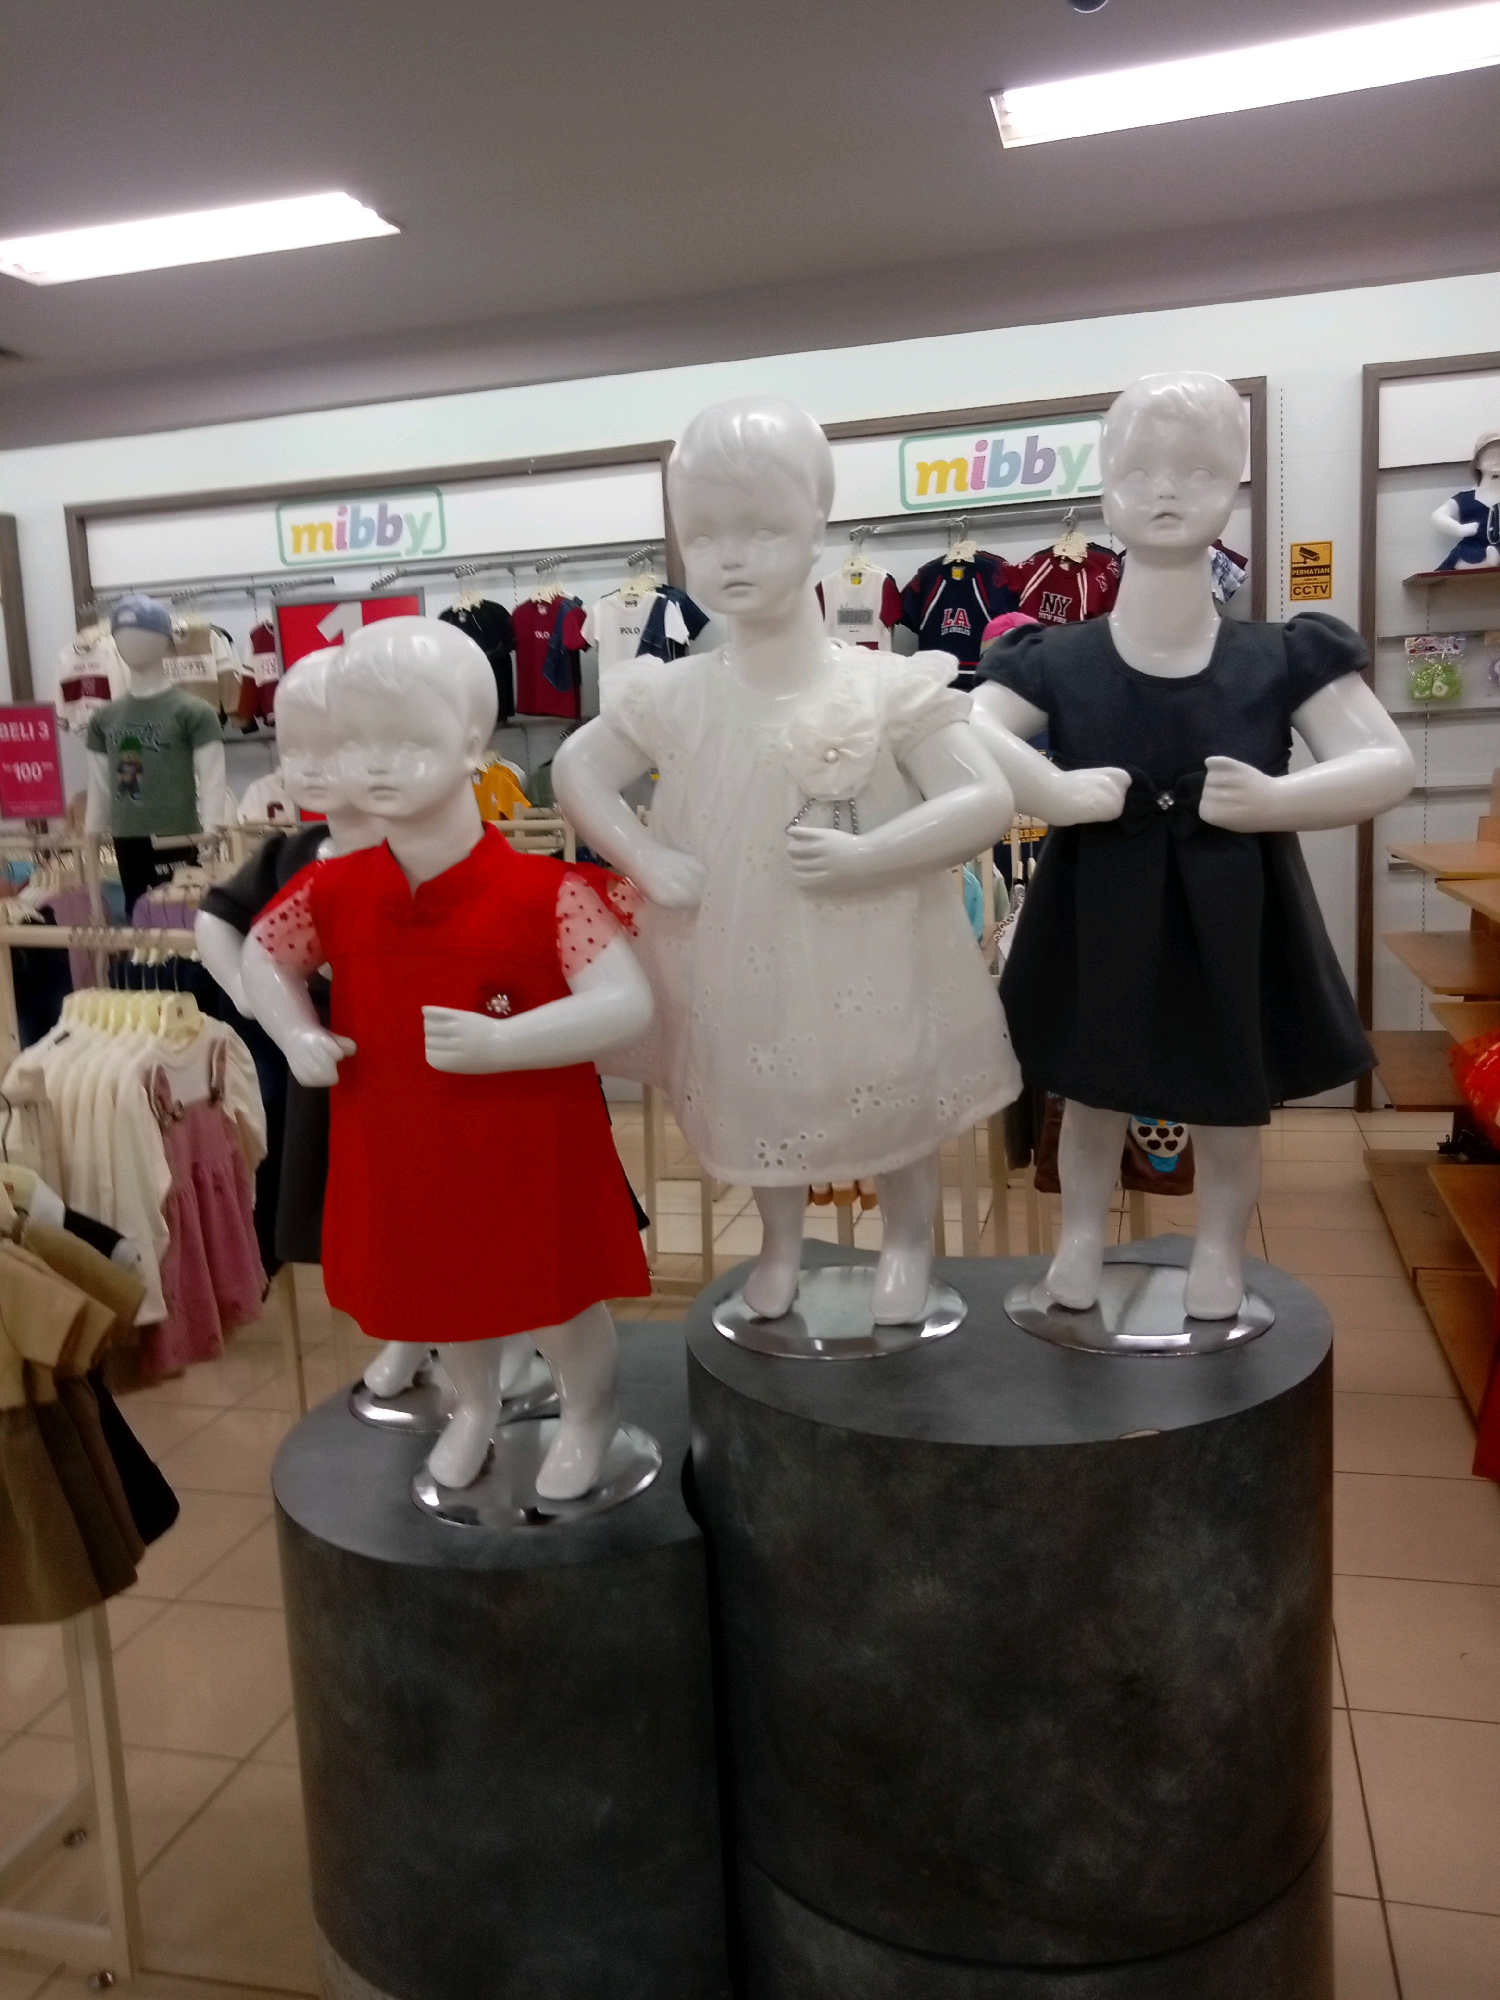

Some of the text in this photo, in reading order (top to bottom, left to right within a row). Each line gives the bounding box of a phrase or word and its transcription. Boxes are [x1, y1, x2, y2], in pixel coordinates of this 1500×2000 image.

[916, 435, 1095, 496] mibby
[291, 501, 433, 556] mibby
[1292, 567, 1330, 576] PERHATIAN
[1293, 584, 1329, 596] CCTV
[1040, 591, 1073, 617] NY
[941, 607, 971, 629] LA
